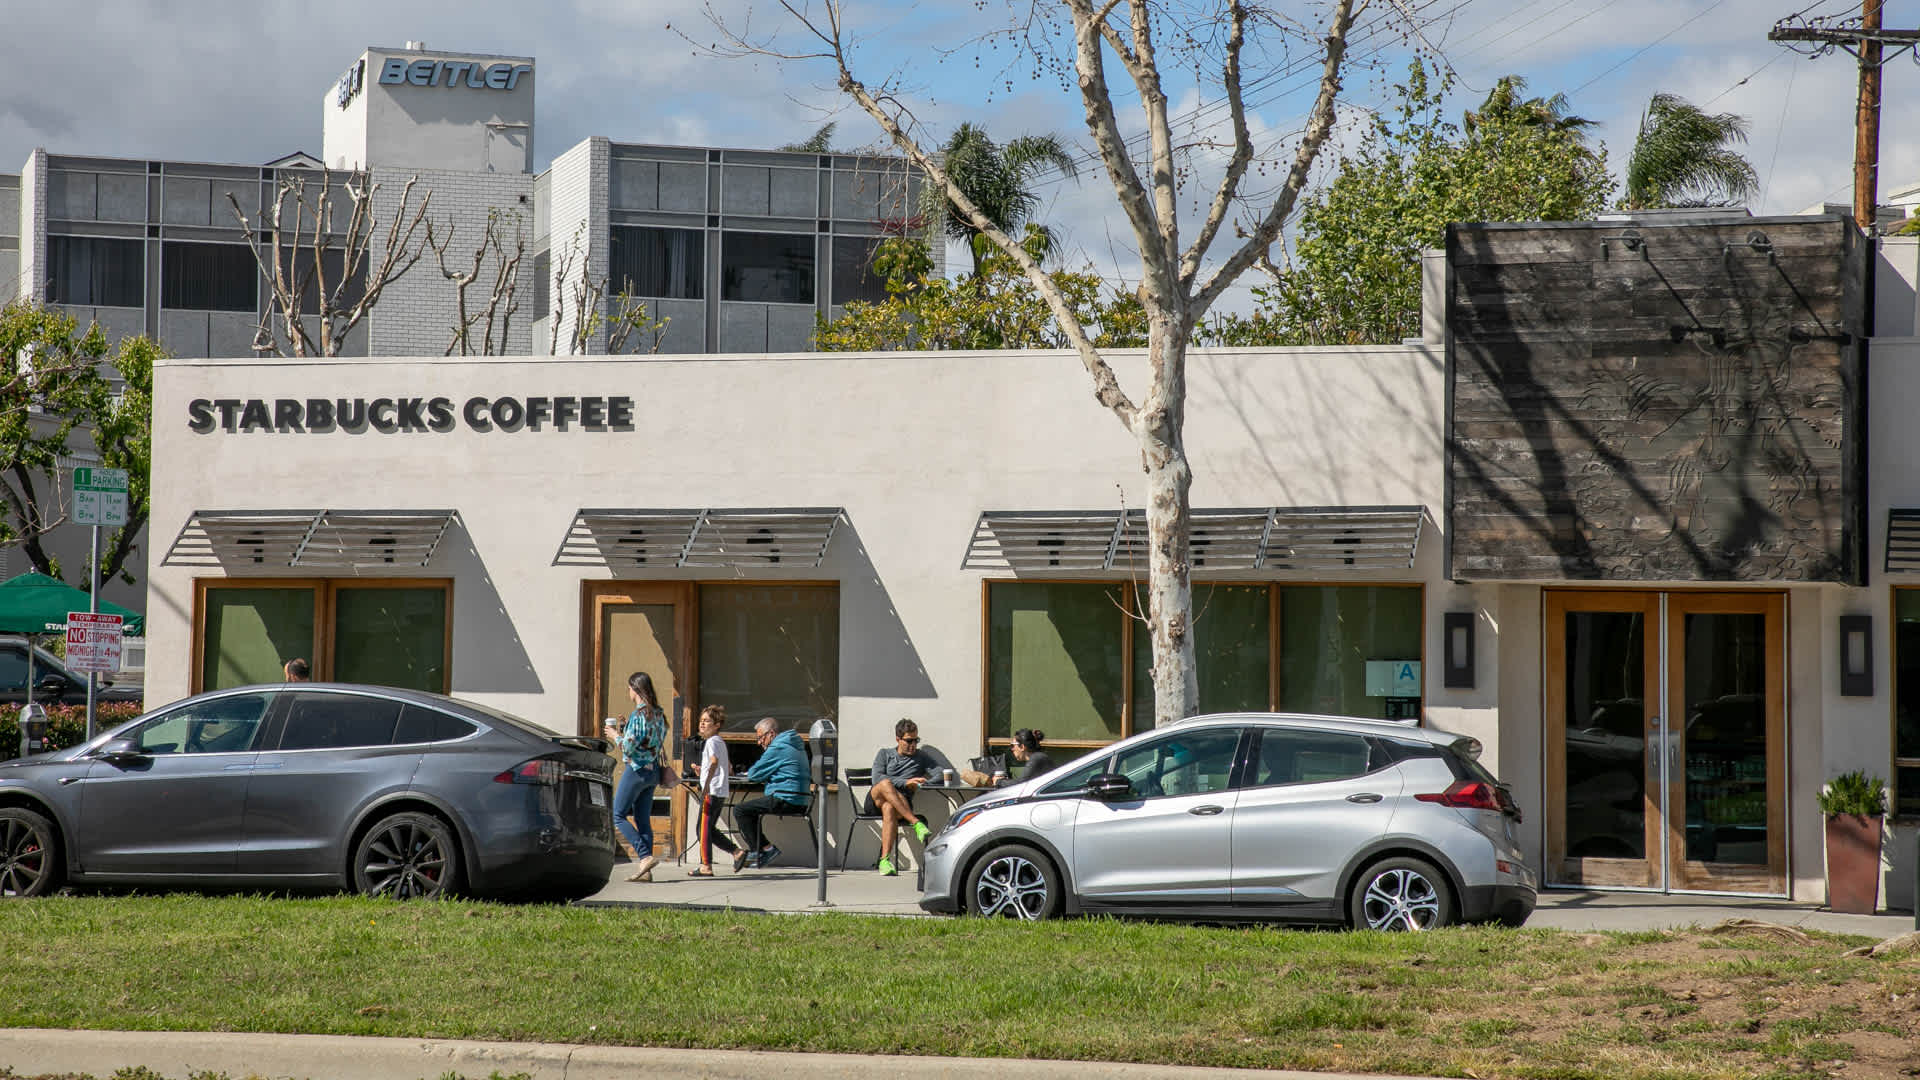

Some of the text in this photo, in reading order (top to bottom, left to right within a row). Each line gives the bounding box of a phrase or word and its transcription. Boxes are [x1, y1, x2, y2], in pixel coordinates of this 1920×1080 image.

[188, 396, 632, 431] STARBUCKS COFFEE
[92, 475, 126, 488] PARKING
[70, 629, 120, 645] NO STOPPING
[68, 645, 98, 656] MIDNIGHT
[1399, 663, 1415, 680] A
